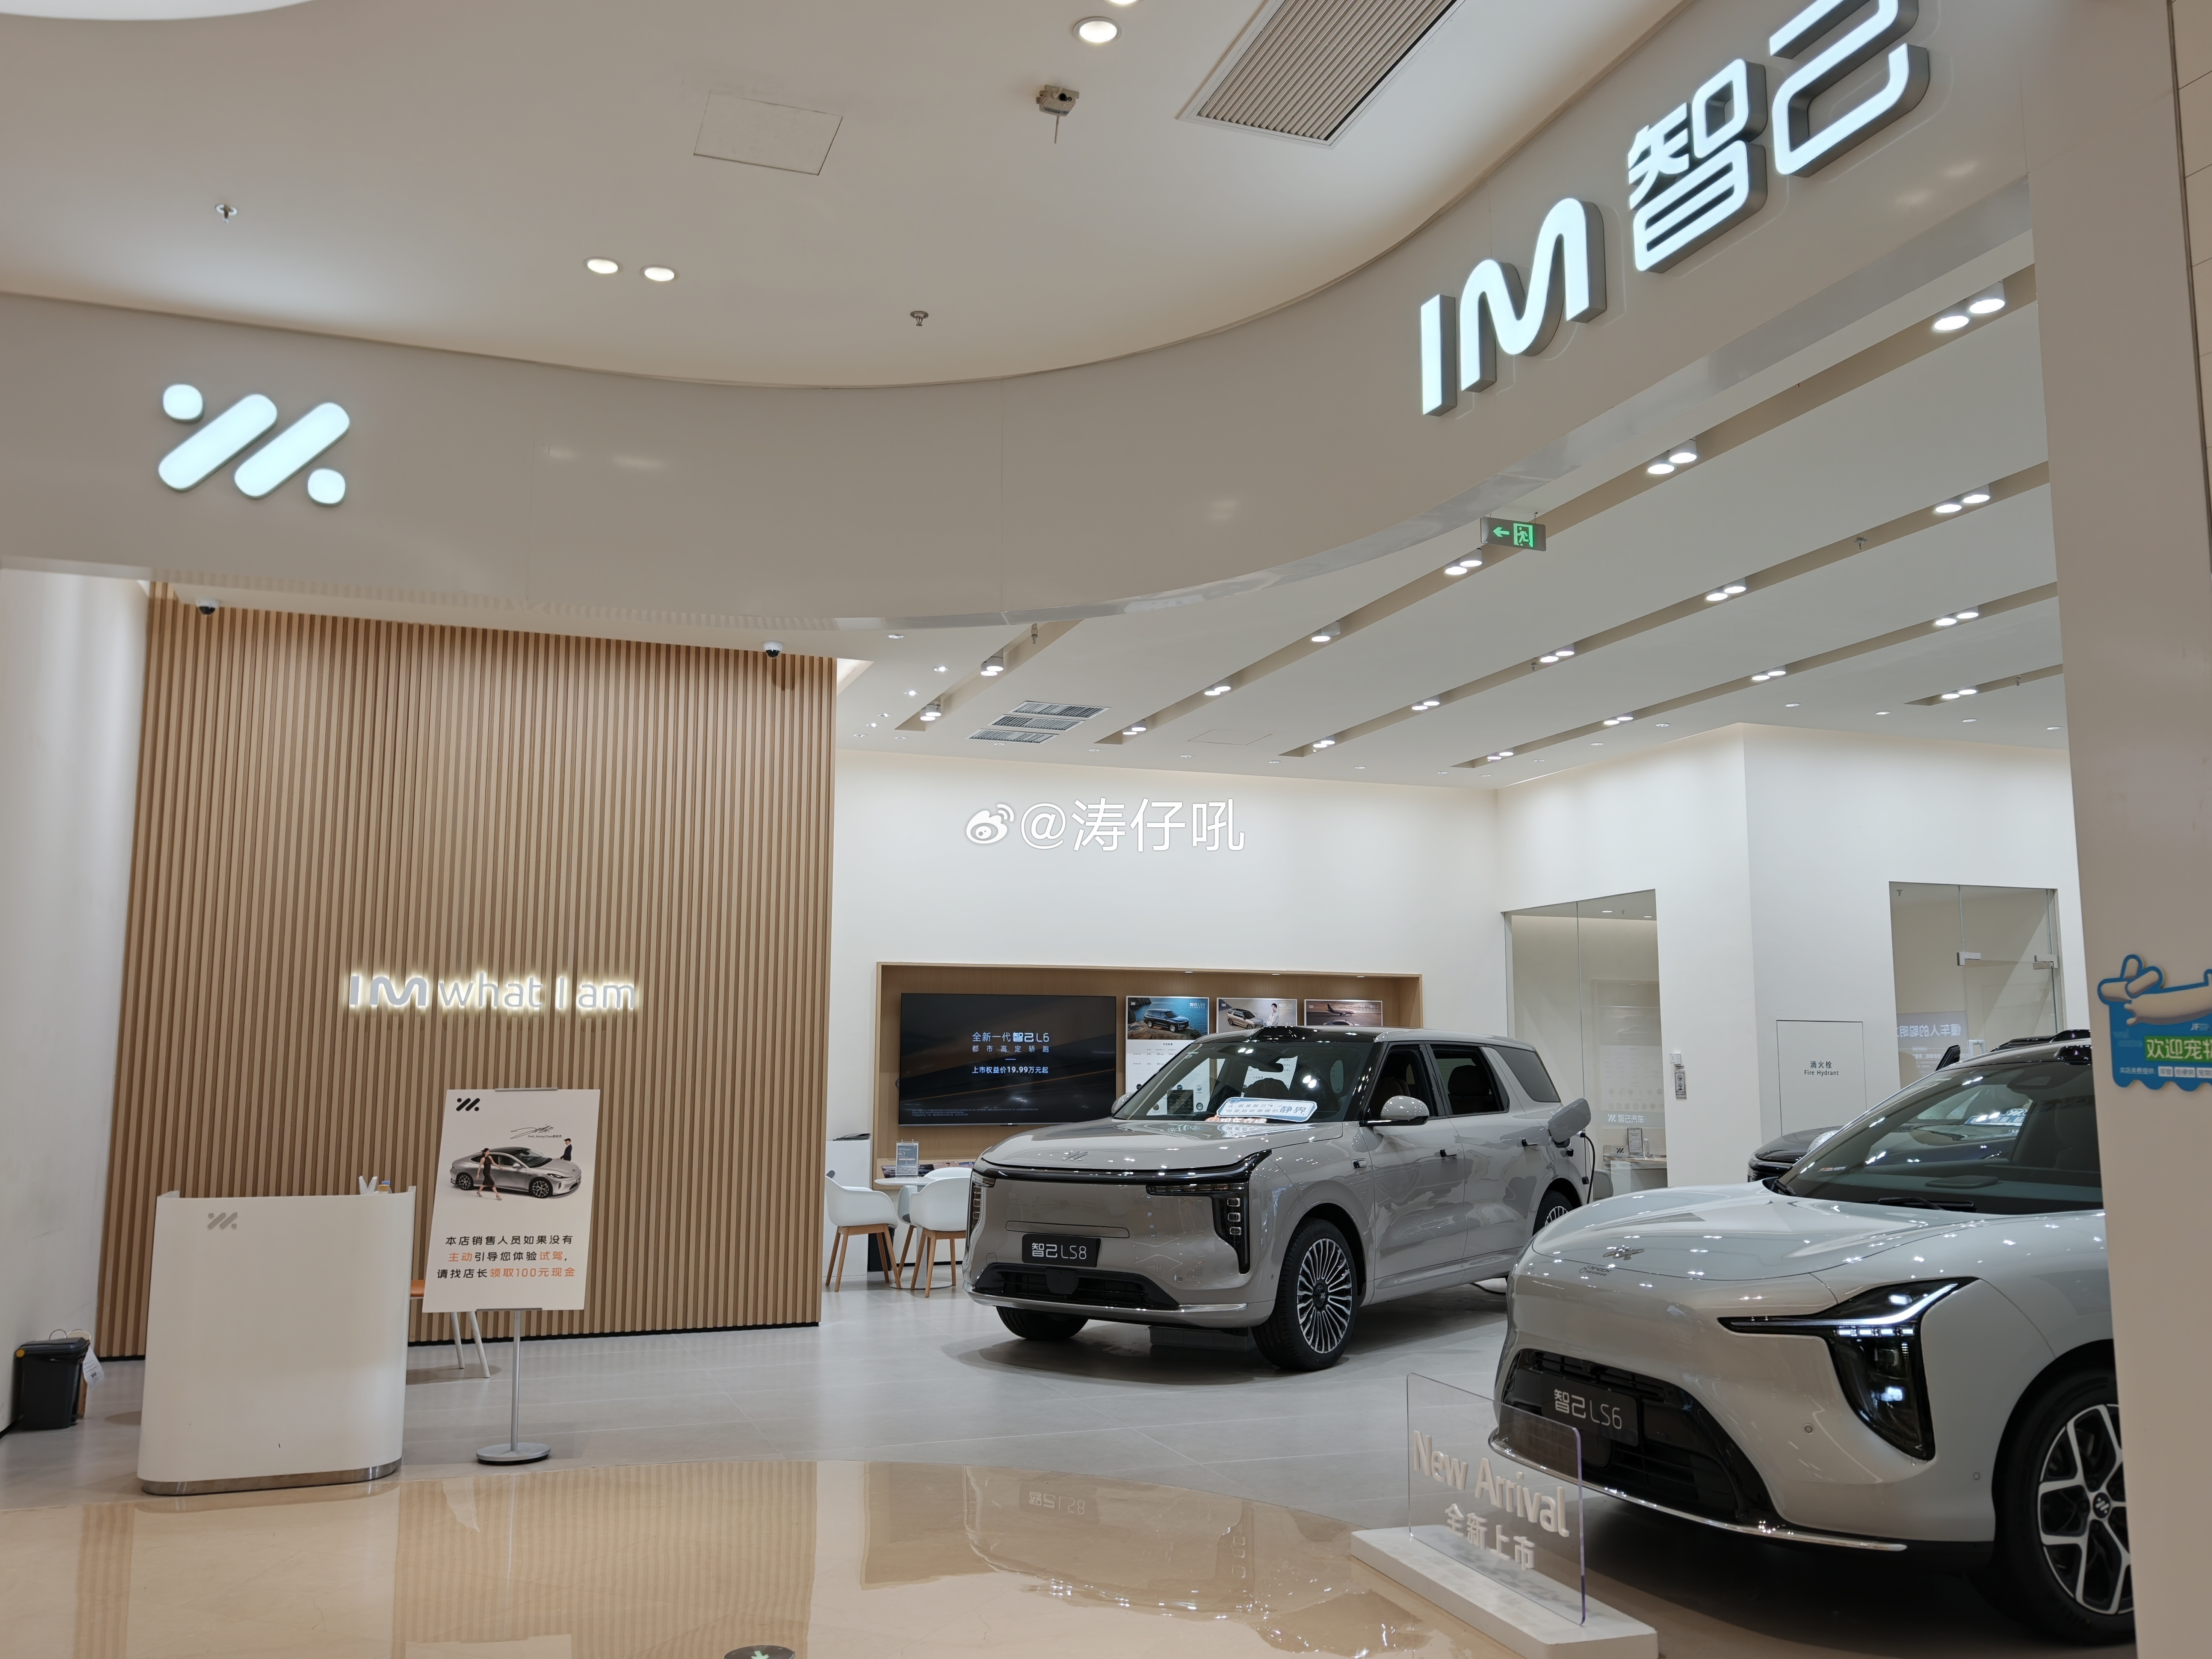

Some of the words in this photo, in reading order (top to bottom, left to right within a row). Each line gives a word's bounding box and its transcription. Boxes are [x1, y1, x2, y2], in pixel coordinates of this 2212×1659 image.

[1421, 197, 1606, 417] IM
[1628, 0, 1930, 273] 智己
[349, 976, 427, 1006] IM
[439, 973, 542, 1007] what
[558, 978, 565, 1008] I
[579, 984, 636, 1008] am
[972, 1032, 1049, 1043] 全新一代智己L6
[1618, 1114, 1644, 1123] 智己汽车
[446, 1235, 573, 1246] 本店销售人员如果没有
[1032, 1242, 1087, 1260] 智己LS8
[437, 1267, 575, 1279] 请找店长领取100元现金
[1554, 1389, 1622, 1429] 智己LS6
[1413, 1430, 1468, 1491] New
[1475, 1458, 1570, 1537] Arrival
[1445, 1503, 1535, 1571] 全新上市
